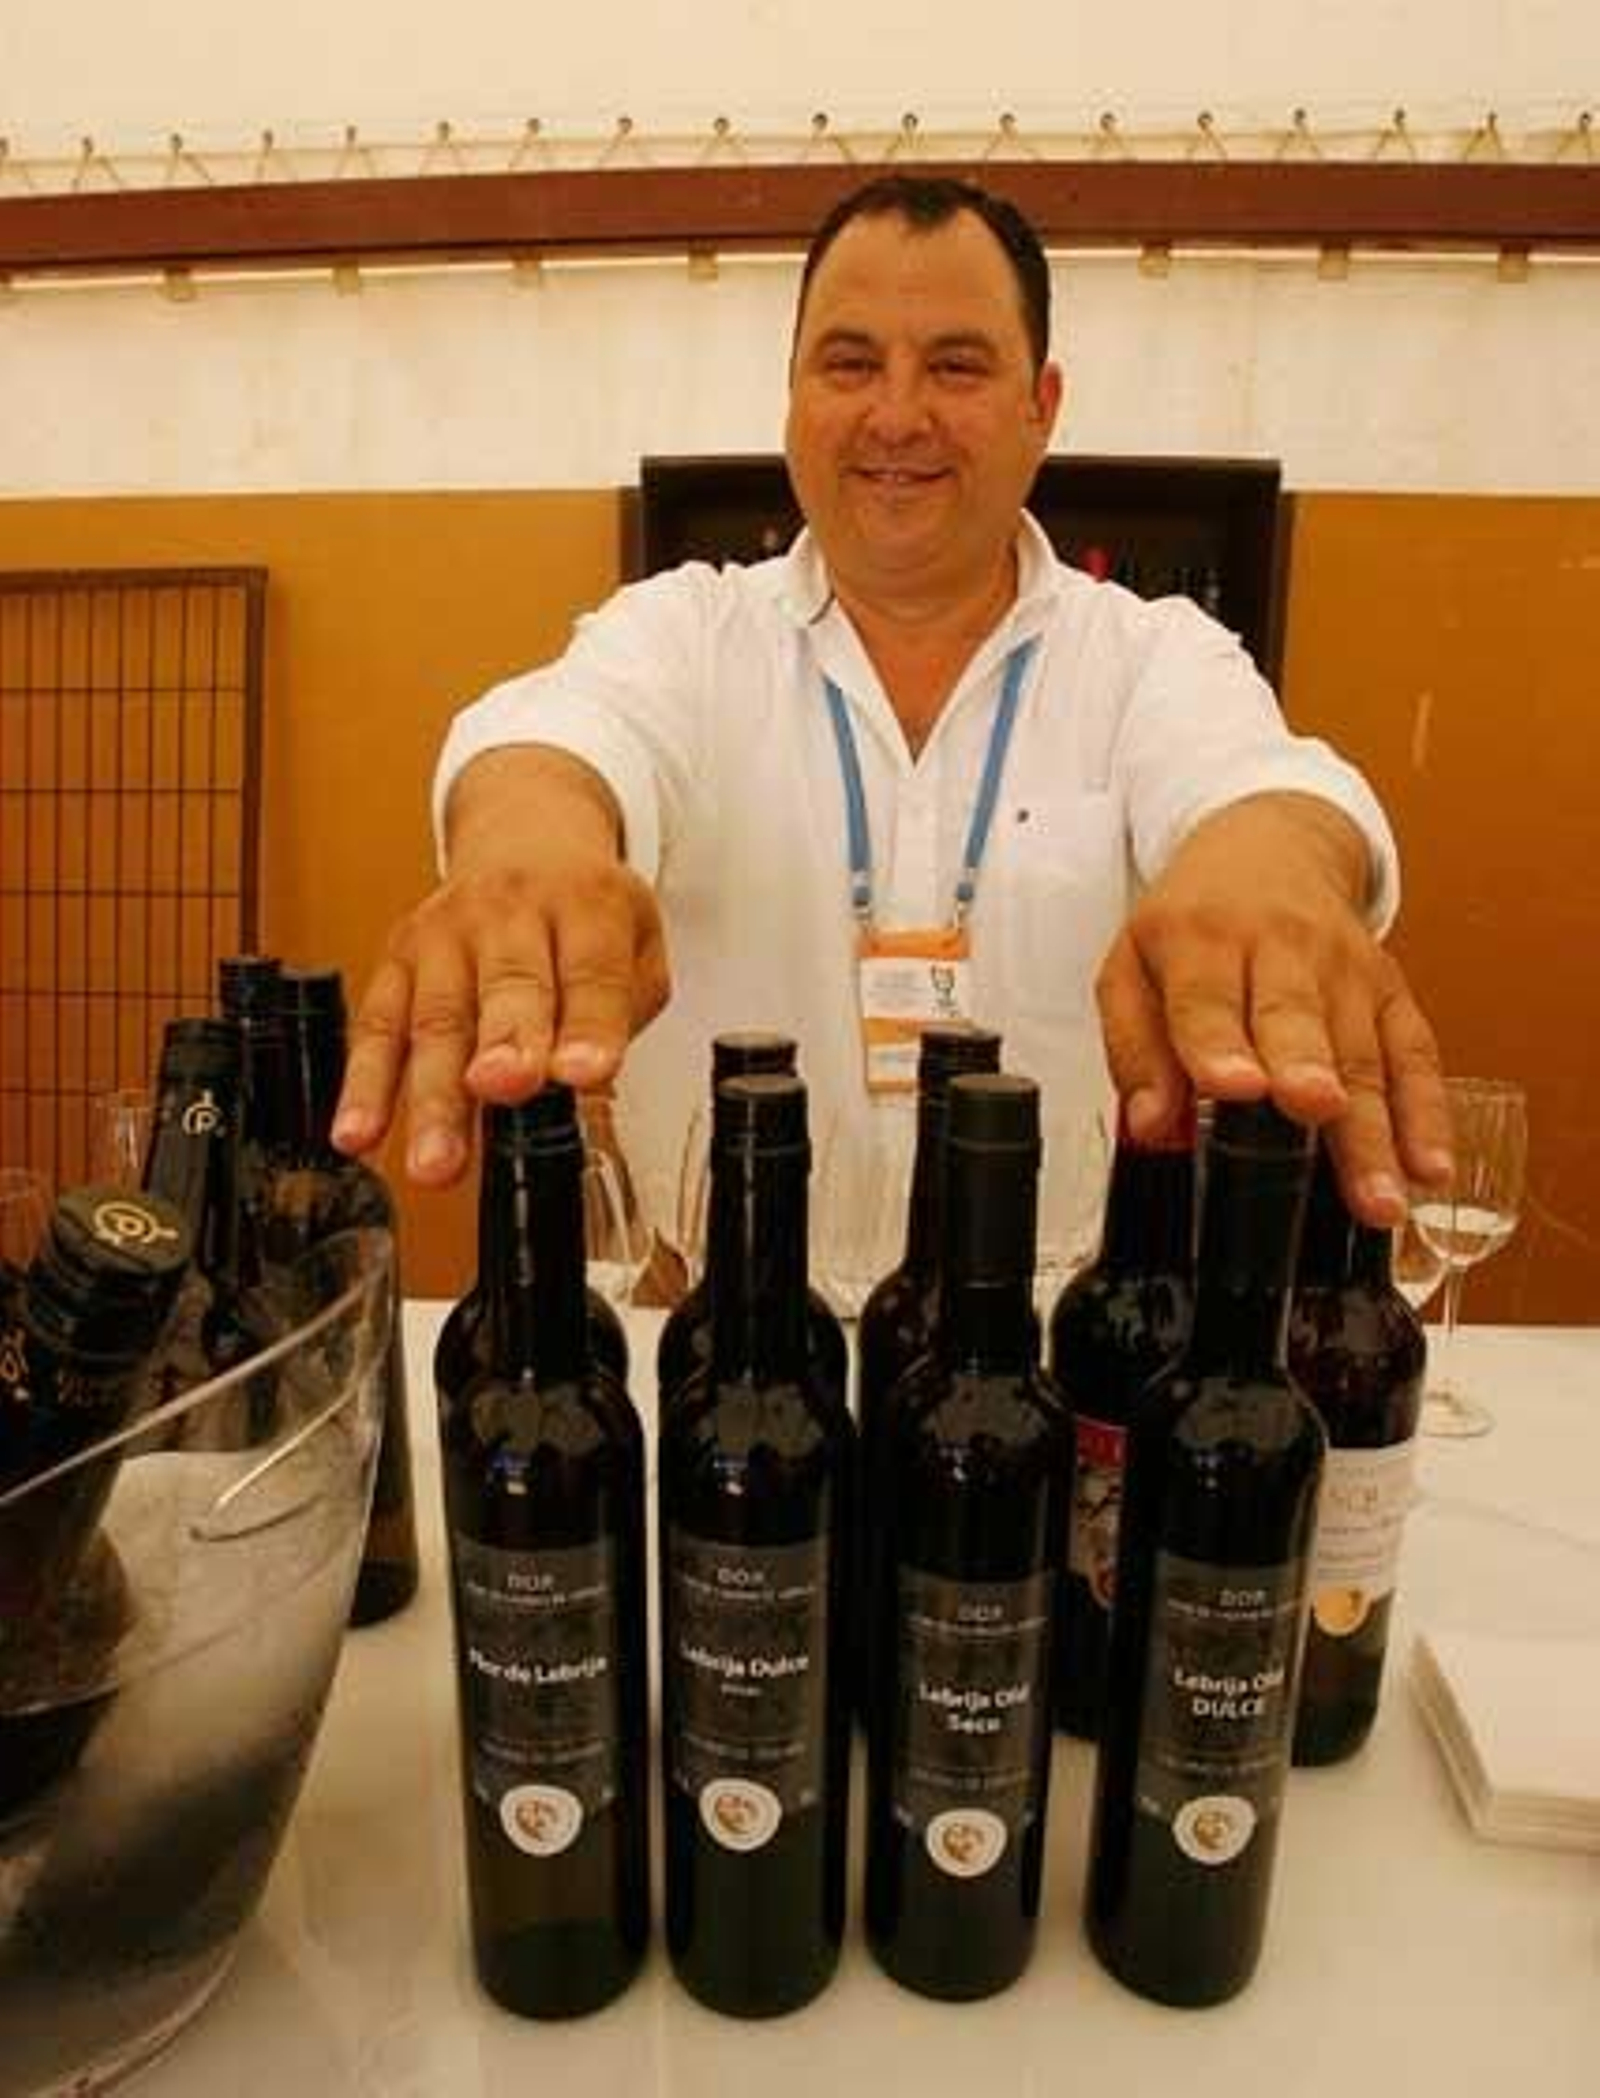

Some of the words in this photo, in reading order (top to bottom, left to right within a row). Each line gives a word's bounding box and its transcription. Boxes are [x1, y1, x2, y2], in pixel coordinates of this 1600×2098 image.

[534, 1656, 607, 1683] Lebrija
[1174, 1666, 1248, 1697] Lebrija
[919, 1679, 990, 1713] Lebrija
